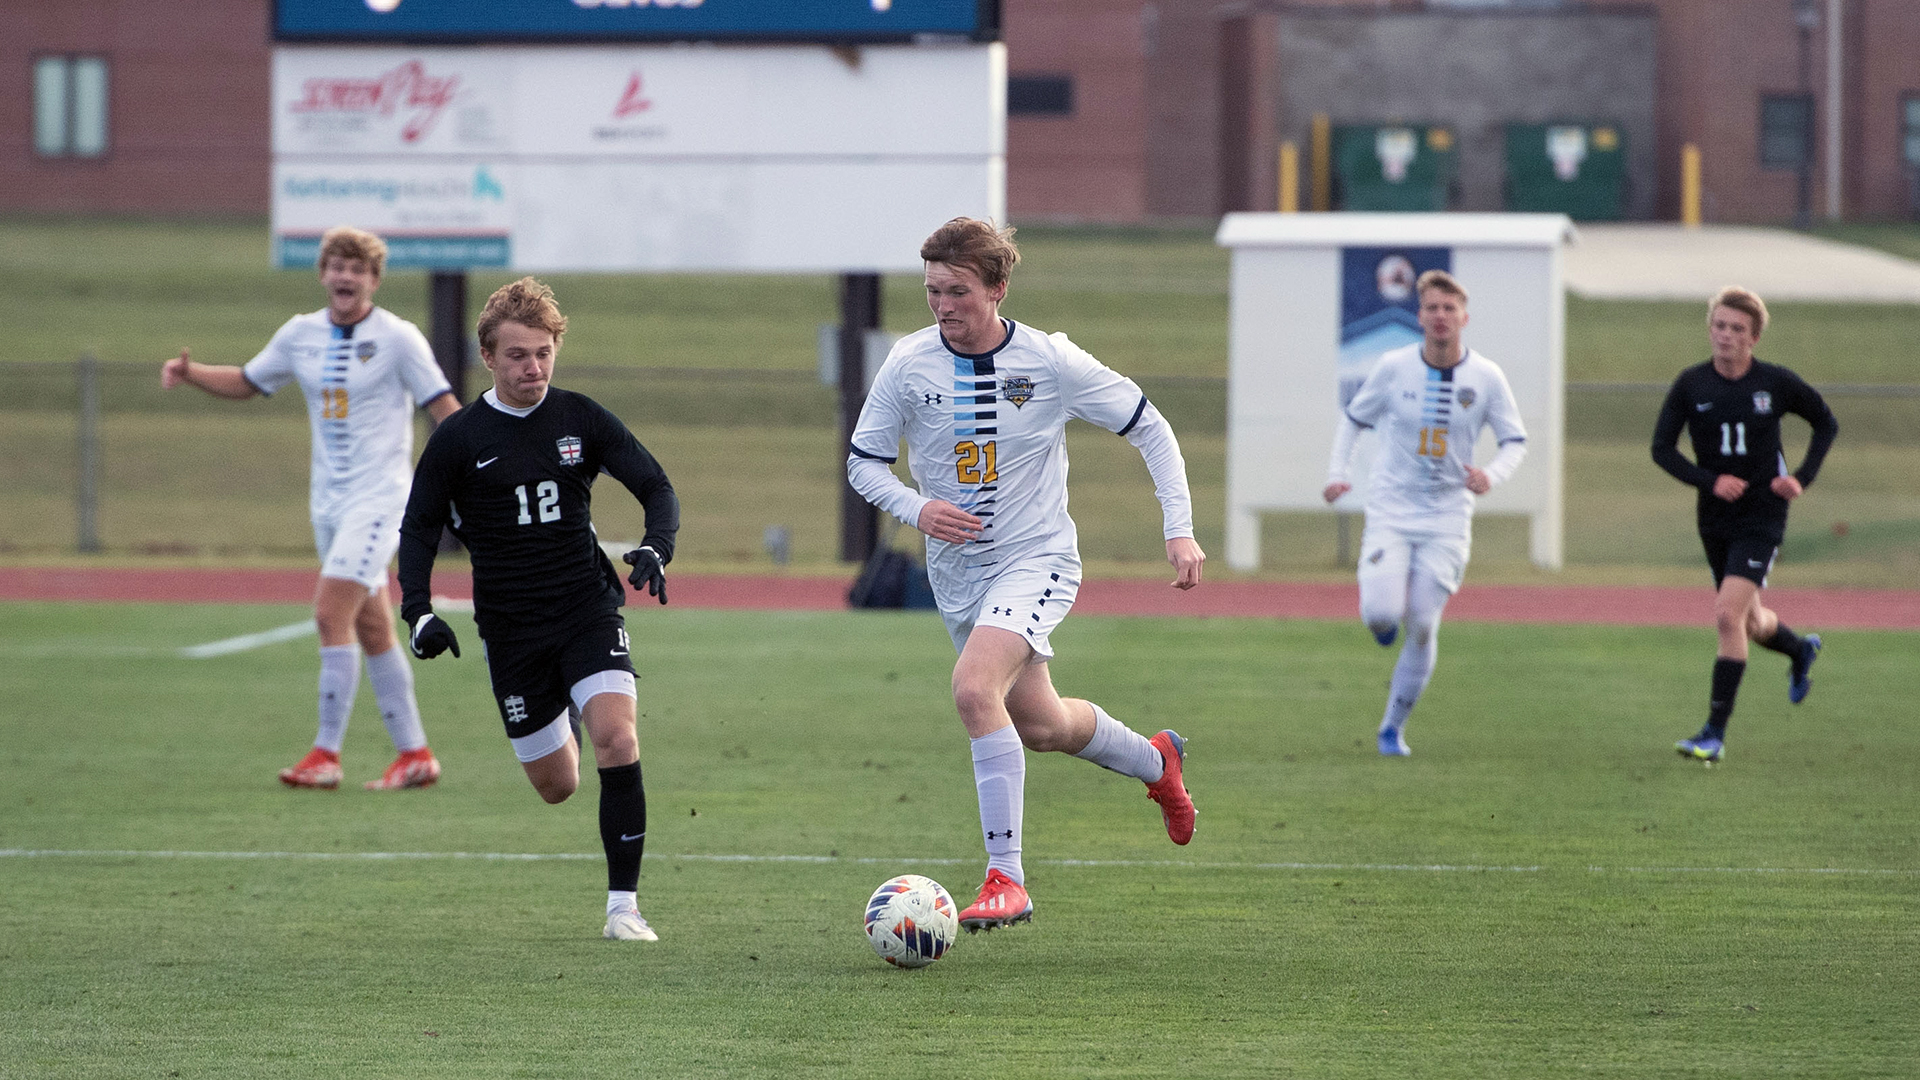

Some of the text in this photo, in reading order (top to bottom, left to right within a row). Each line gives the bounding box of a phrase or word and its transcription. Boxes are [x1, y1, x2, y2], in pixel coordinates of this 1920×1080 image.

[1417, 427, 1449, 458] 15
[1720, 422, 1747, 456] 11
[954, 440, 999, 484] 21
[514, 479, 562, 525] 12
